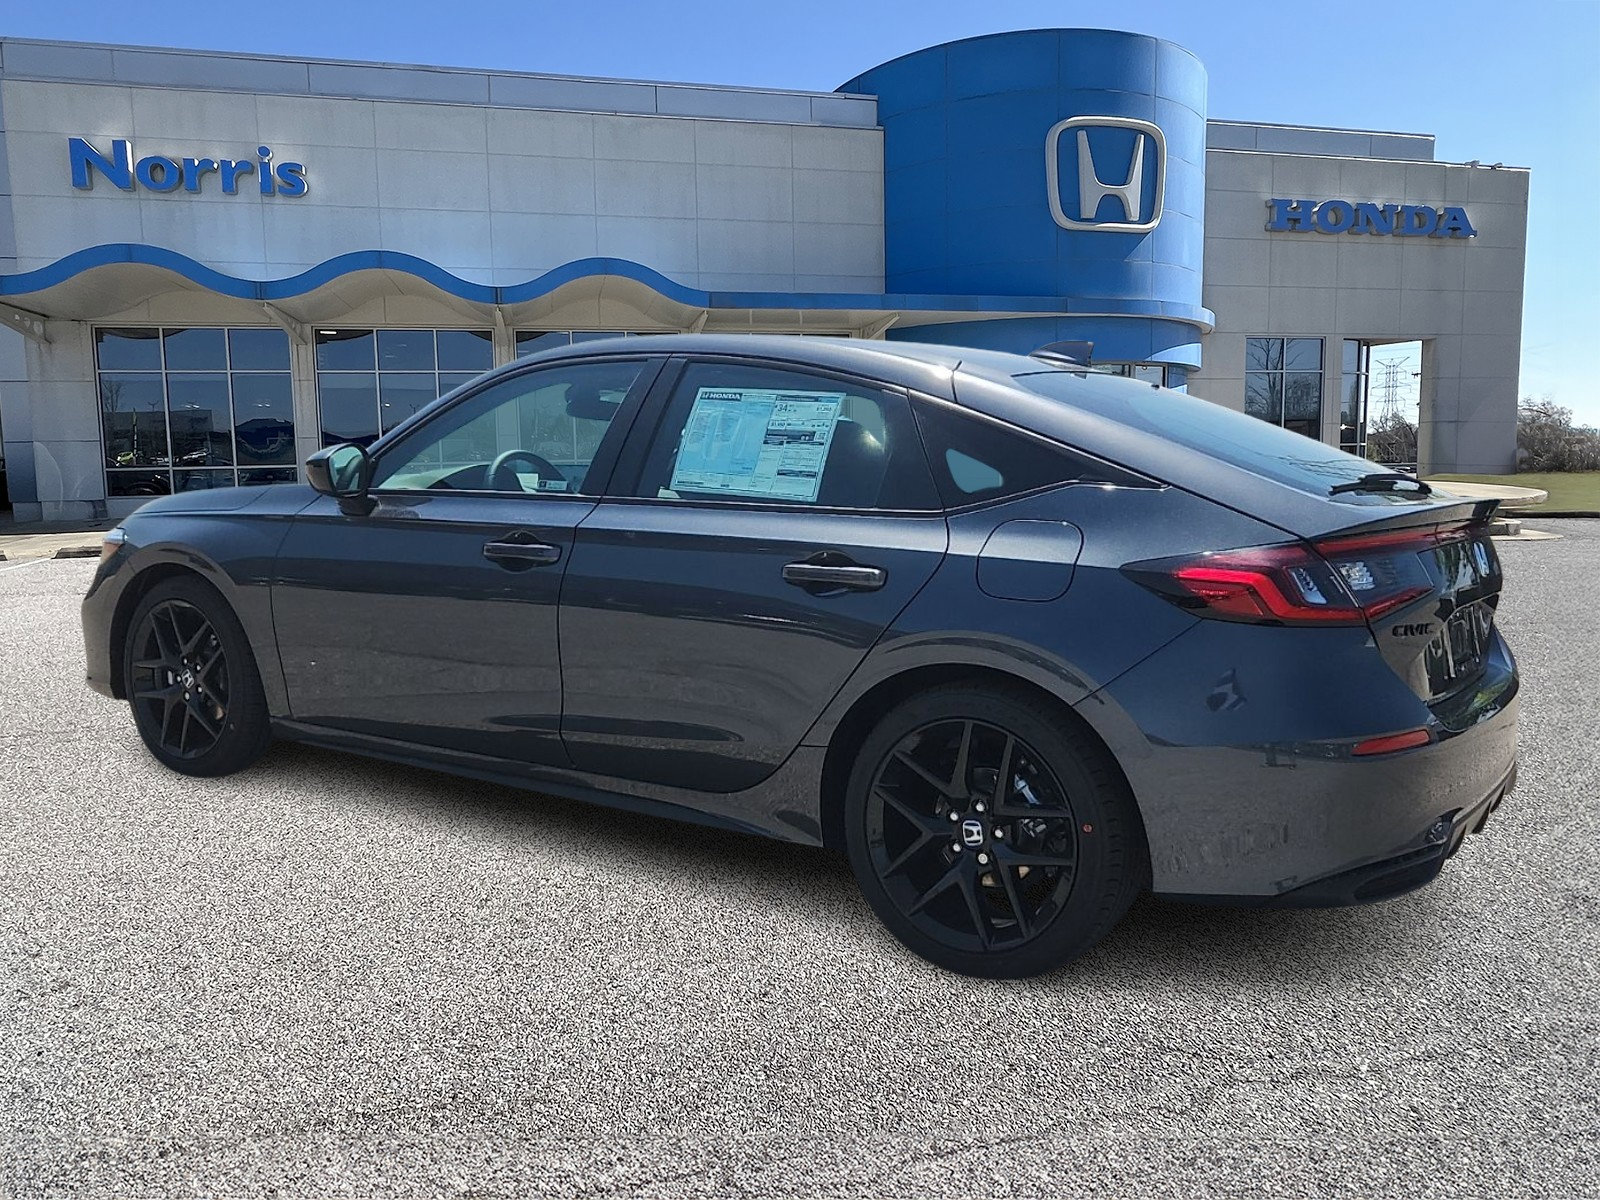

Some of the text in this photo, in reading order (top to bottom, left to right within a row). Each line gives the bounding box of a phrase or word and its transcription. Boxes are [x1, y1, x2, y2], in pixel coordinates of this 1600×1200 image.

[68, 137, 308, 197] Norris
[1265, 198, 1477, 239] HONDA
[1392, 622, 1435, 637] CIVIC
